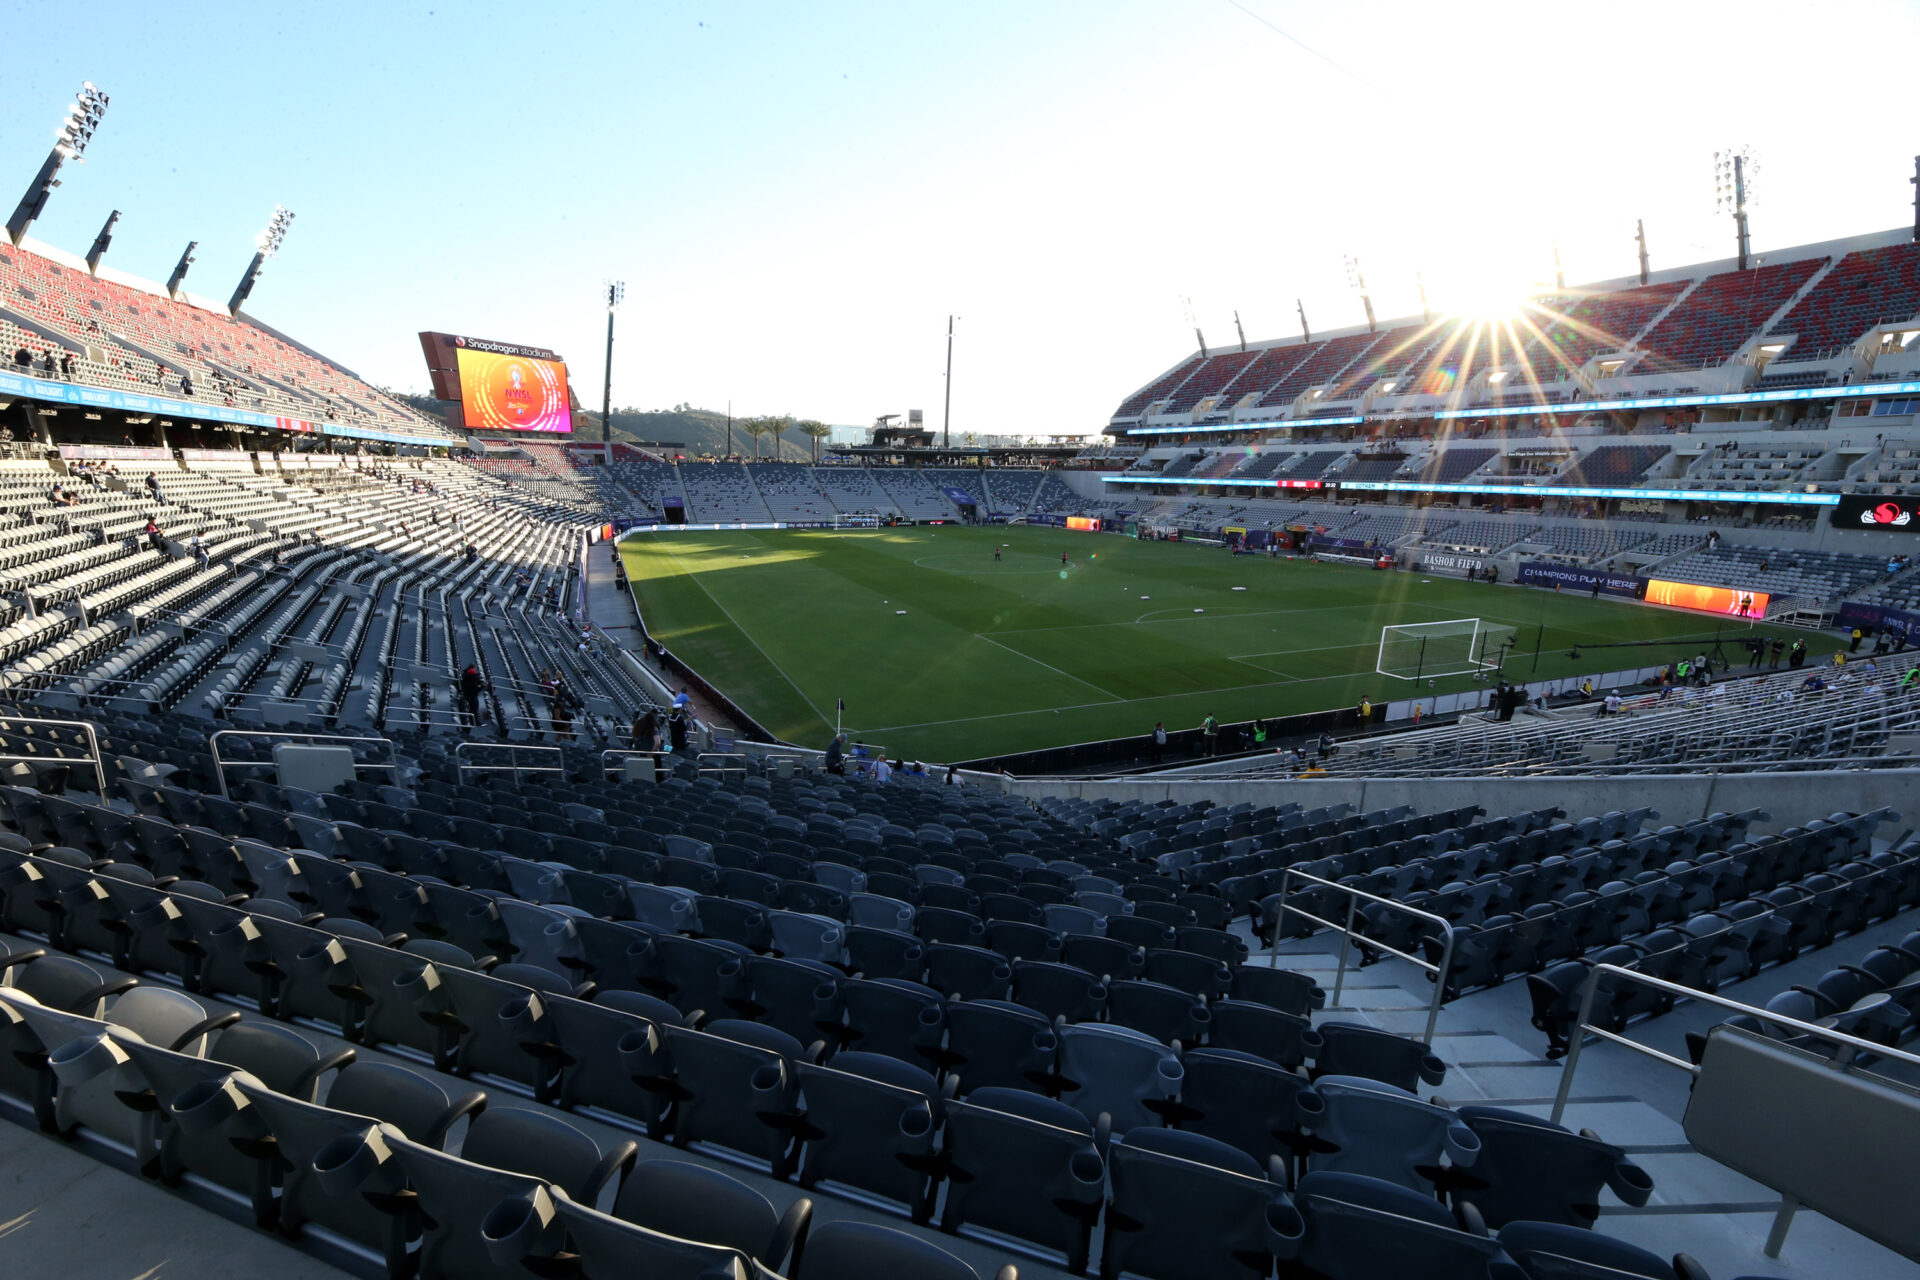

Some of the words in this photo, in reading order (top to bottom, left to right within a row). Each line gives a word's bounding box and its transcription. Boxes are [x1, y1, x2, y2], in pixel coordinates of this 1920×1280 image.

[468, 338, 519, 355] Snapdragon
[520, 347, 551, 359] stadium
[505, 388, 532, 399] NWSL
[1424, 554, 1455, 567] BASHOR
[1457, 558, 1482, 570] FIELD
[1524, 568, 1577, 582] CHAMPIONS
[1579, 575, 1604, 585] PLAY
[1607, 579, 1638, 590] HERE
